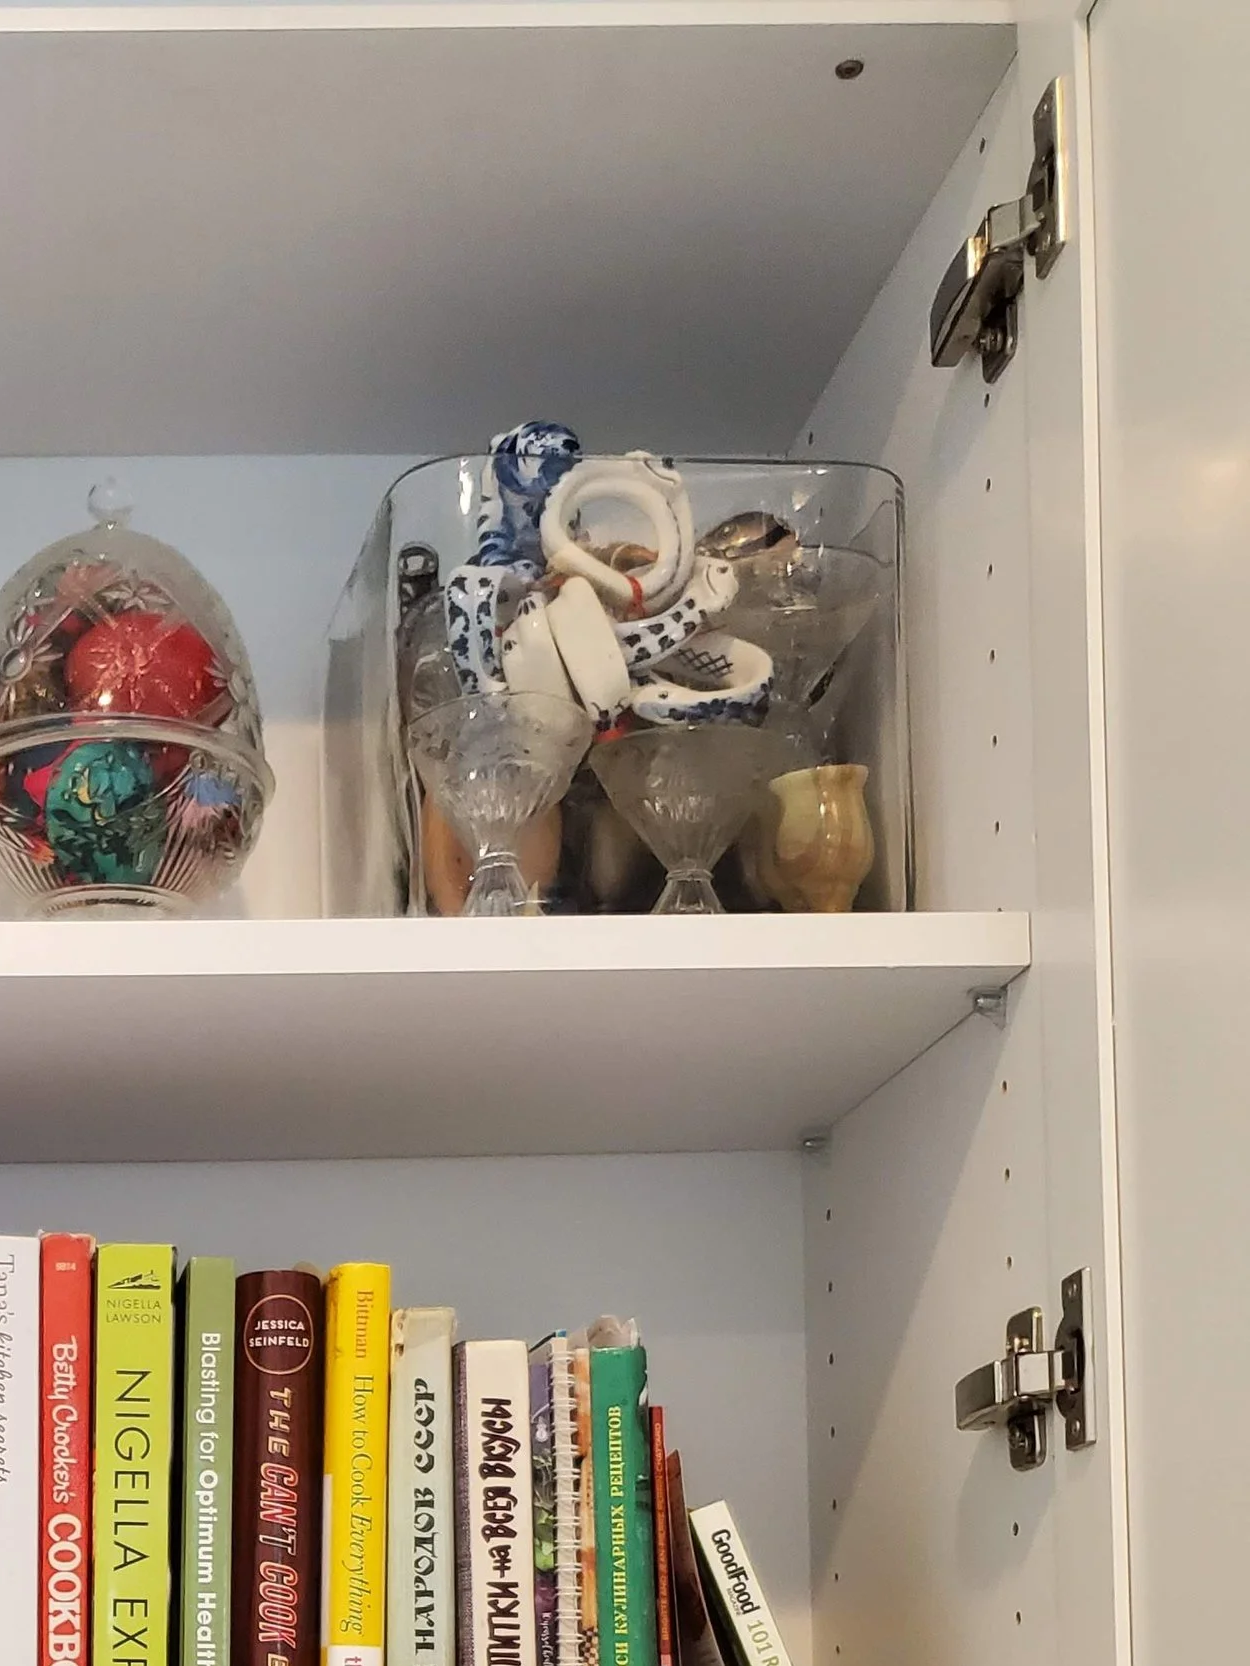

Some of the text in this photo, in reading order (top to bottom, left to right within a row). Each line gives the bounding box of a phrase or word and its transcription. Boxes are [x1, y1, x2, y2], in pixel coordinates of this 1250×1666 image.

[105, 1313, 162, 1324] LAWSON
[106, 1300, 162, 1311] NIGELLA
[249, 1336, 310, 1348] SEINFELD
[254, 1319, 306, 1331] JESSICA
[47, 1335, 78, 1401] Betty
[196, 1332, 221, 1429] Blasting
[51, 1404, 78, 1505] Crocker's
[199, 1432, 220, 1464] for
[268, 1386, 291, 1458] THE
[340, 1290, 374, 1633] Bittman How to Cook Everything
[413, 1377, 435, 1474] СССР
[478, 1398, 520, 1481] ВКУСЫ
[607, 1406, 625, 1497] РЕЦЕПТОВ
[113, 1369, 152, 1572] NIGELLA
[258, 1462, 299, 1556] CAN'T
[195, 1470, 219, 1584] Optimum
[488, 1544, 511, 1579] на
[610, 1505, 629, 1634] КУЛИНАРНЫХ
[258, 1561, 299, 1649] COOK
[414, 1487, 439, 1655] НАРОДОВ
[711, 1528, 761, 1615] GoodFood
[747, 1620, 773, 1655] 101
